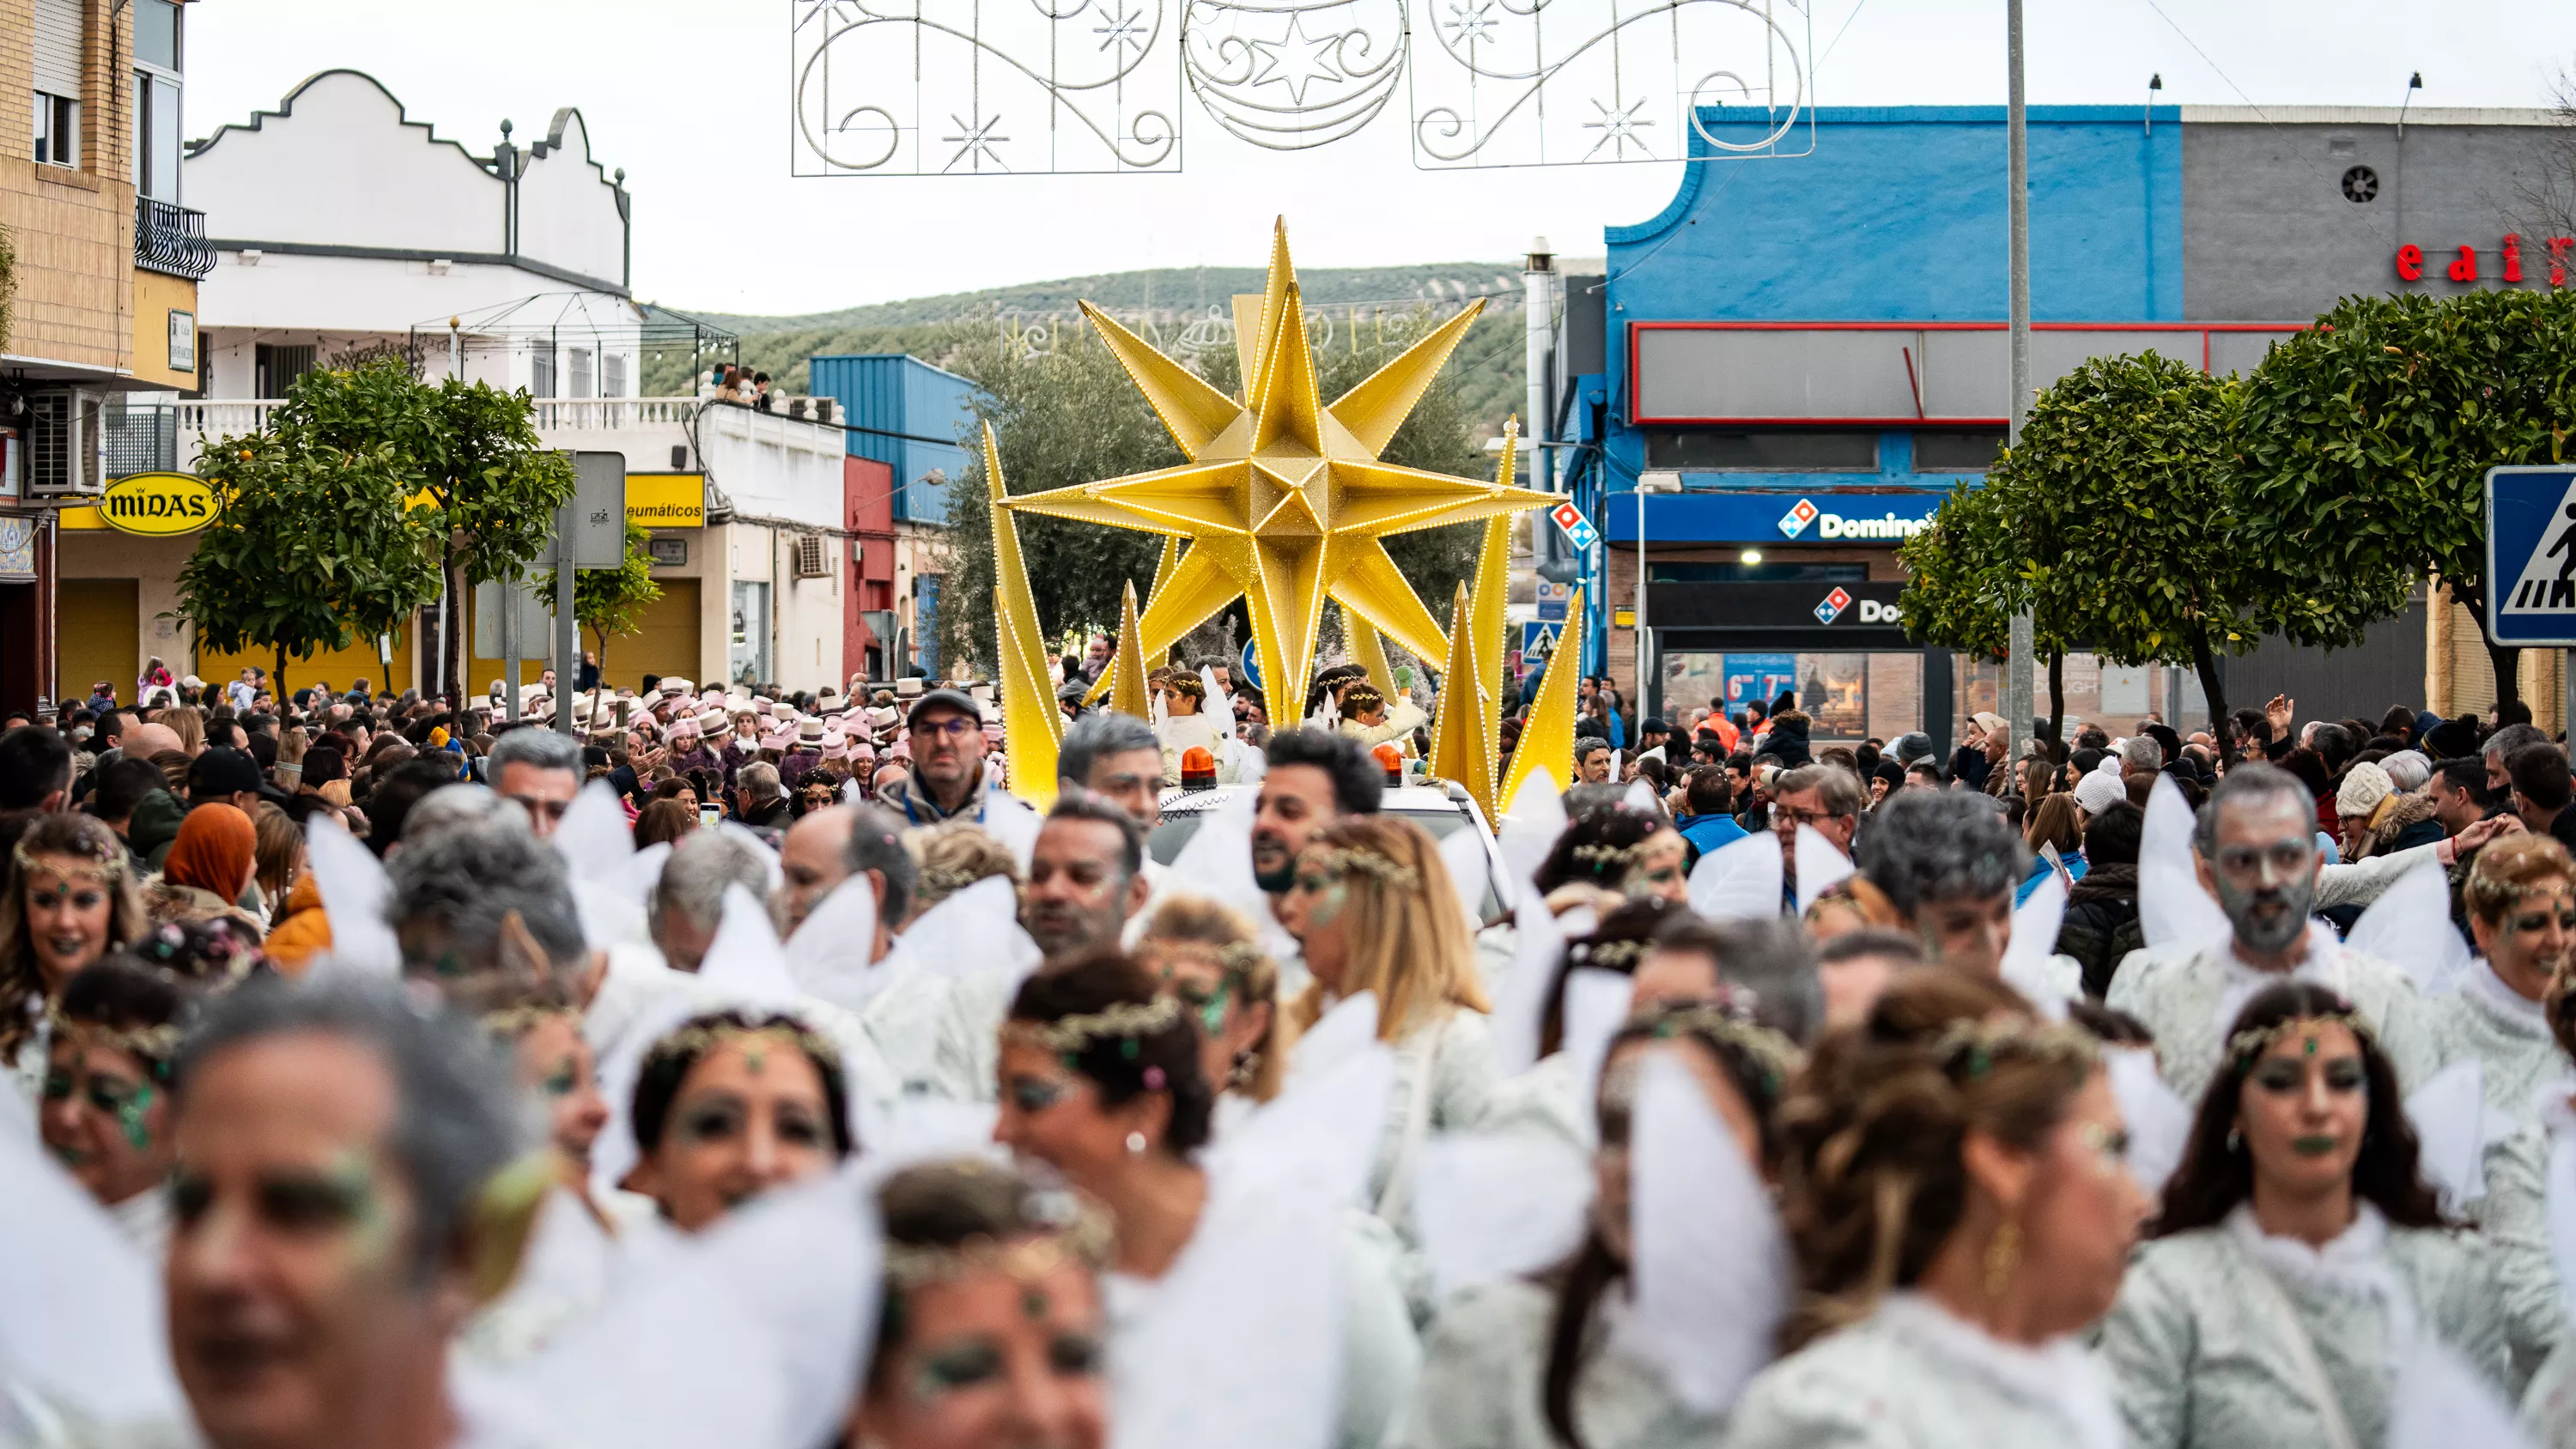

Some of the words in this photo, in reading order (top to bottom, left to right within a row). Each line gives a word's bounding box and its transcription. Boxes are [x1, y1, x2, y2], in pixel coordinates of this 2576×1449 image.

[627, 503, 702, 518] eumáticos
[1819, 512, 1935, 538] Domino'
[2033, 681, 2099, 694] DUGH
